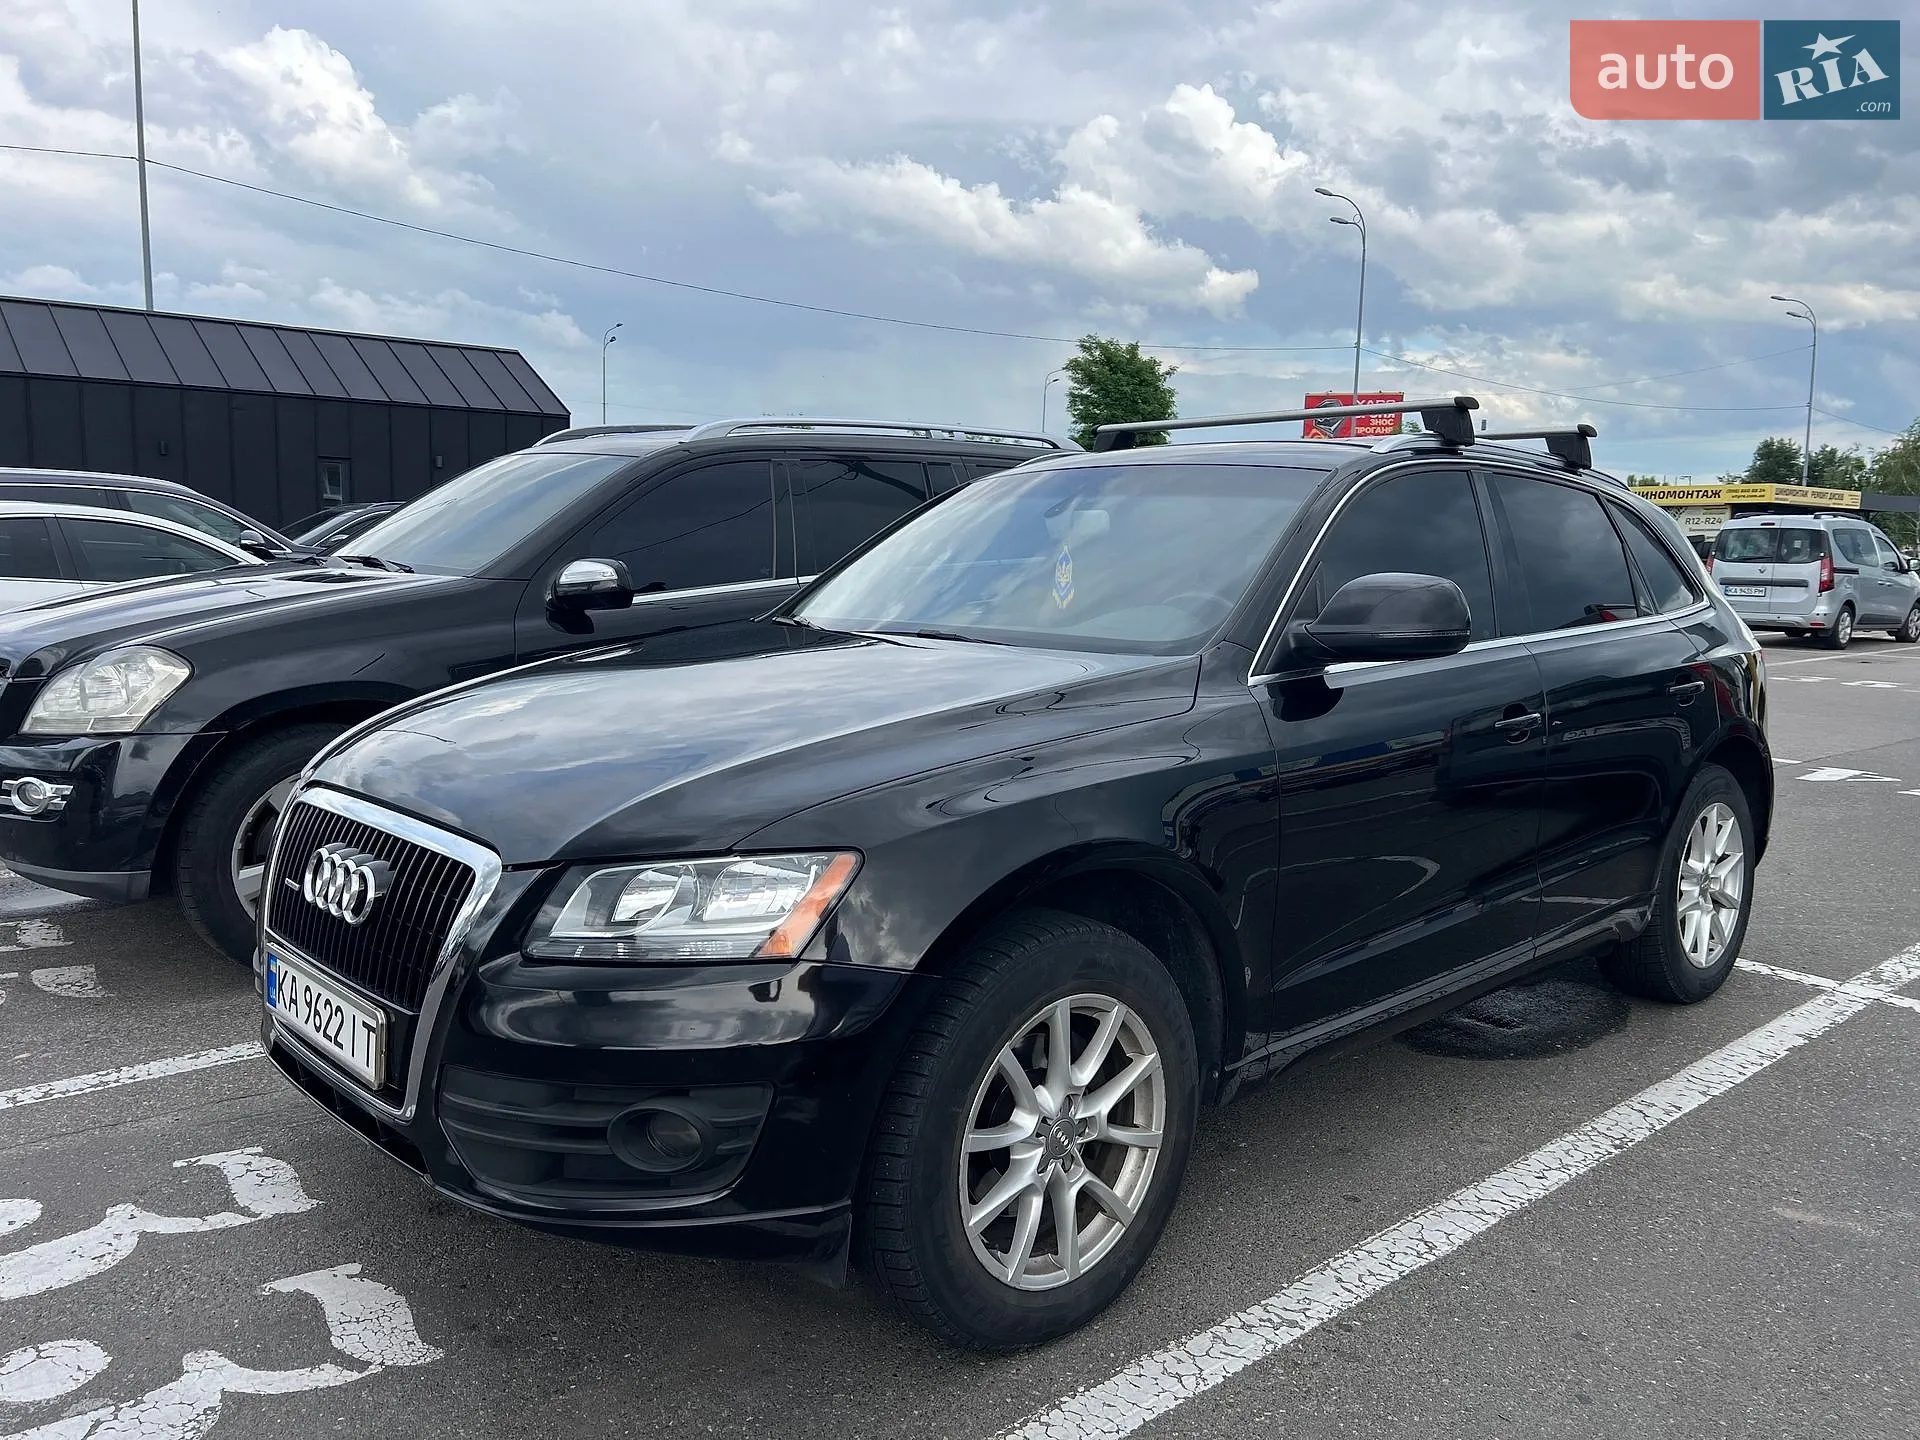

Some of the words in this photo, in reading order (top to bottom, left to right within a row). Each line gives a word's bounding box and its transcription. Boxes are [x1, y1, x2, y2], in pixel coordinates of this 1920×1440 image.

[278, 964, 298, 1018] KA
[303, 984, 345, 1051] 9622
[351, 1013, 376, 1069] IT
